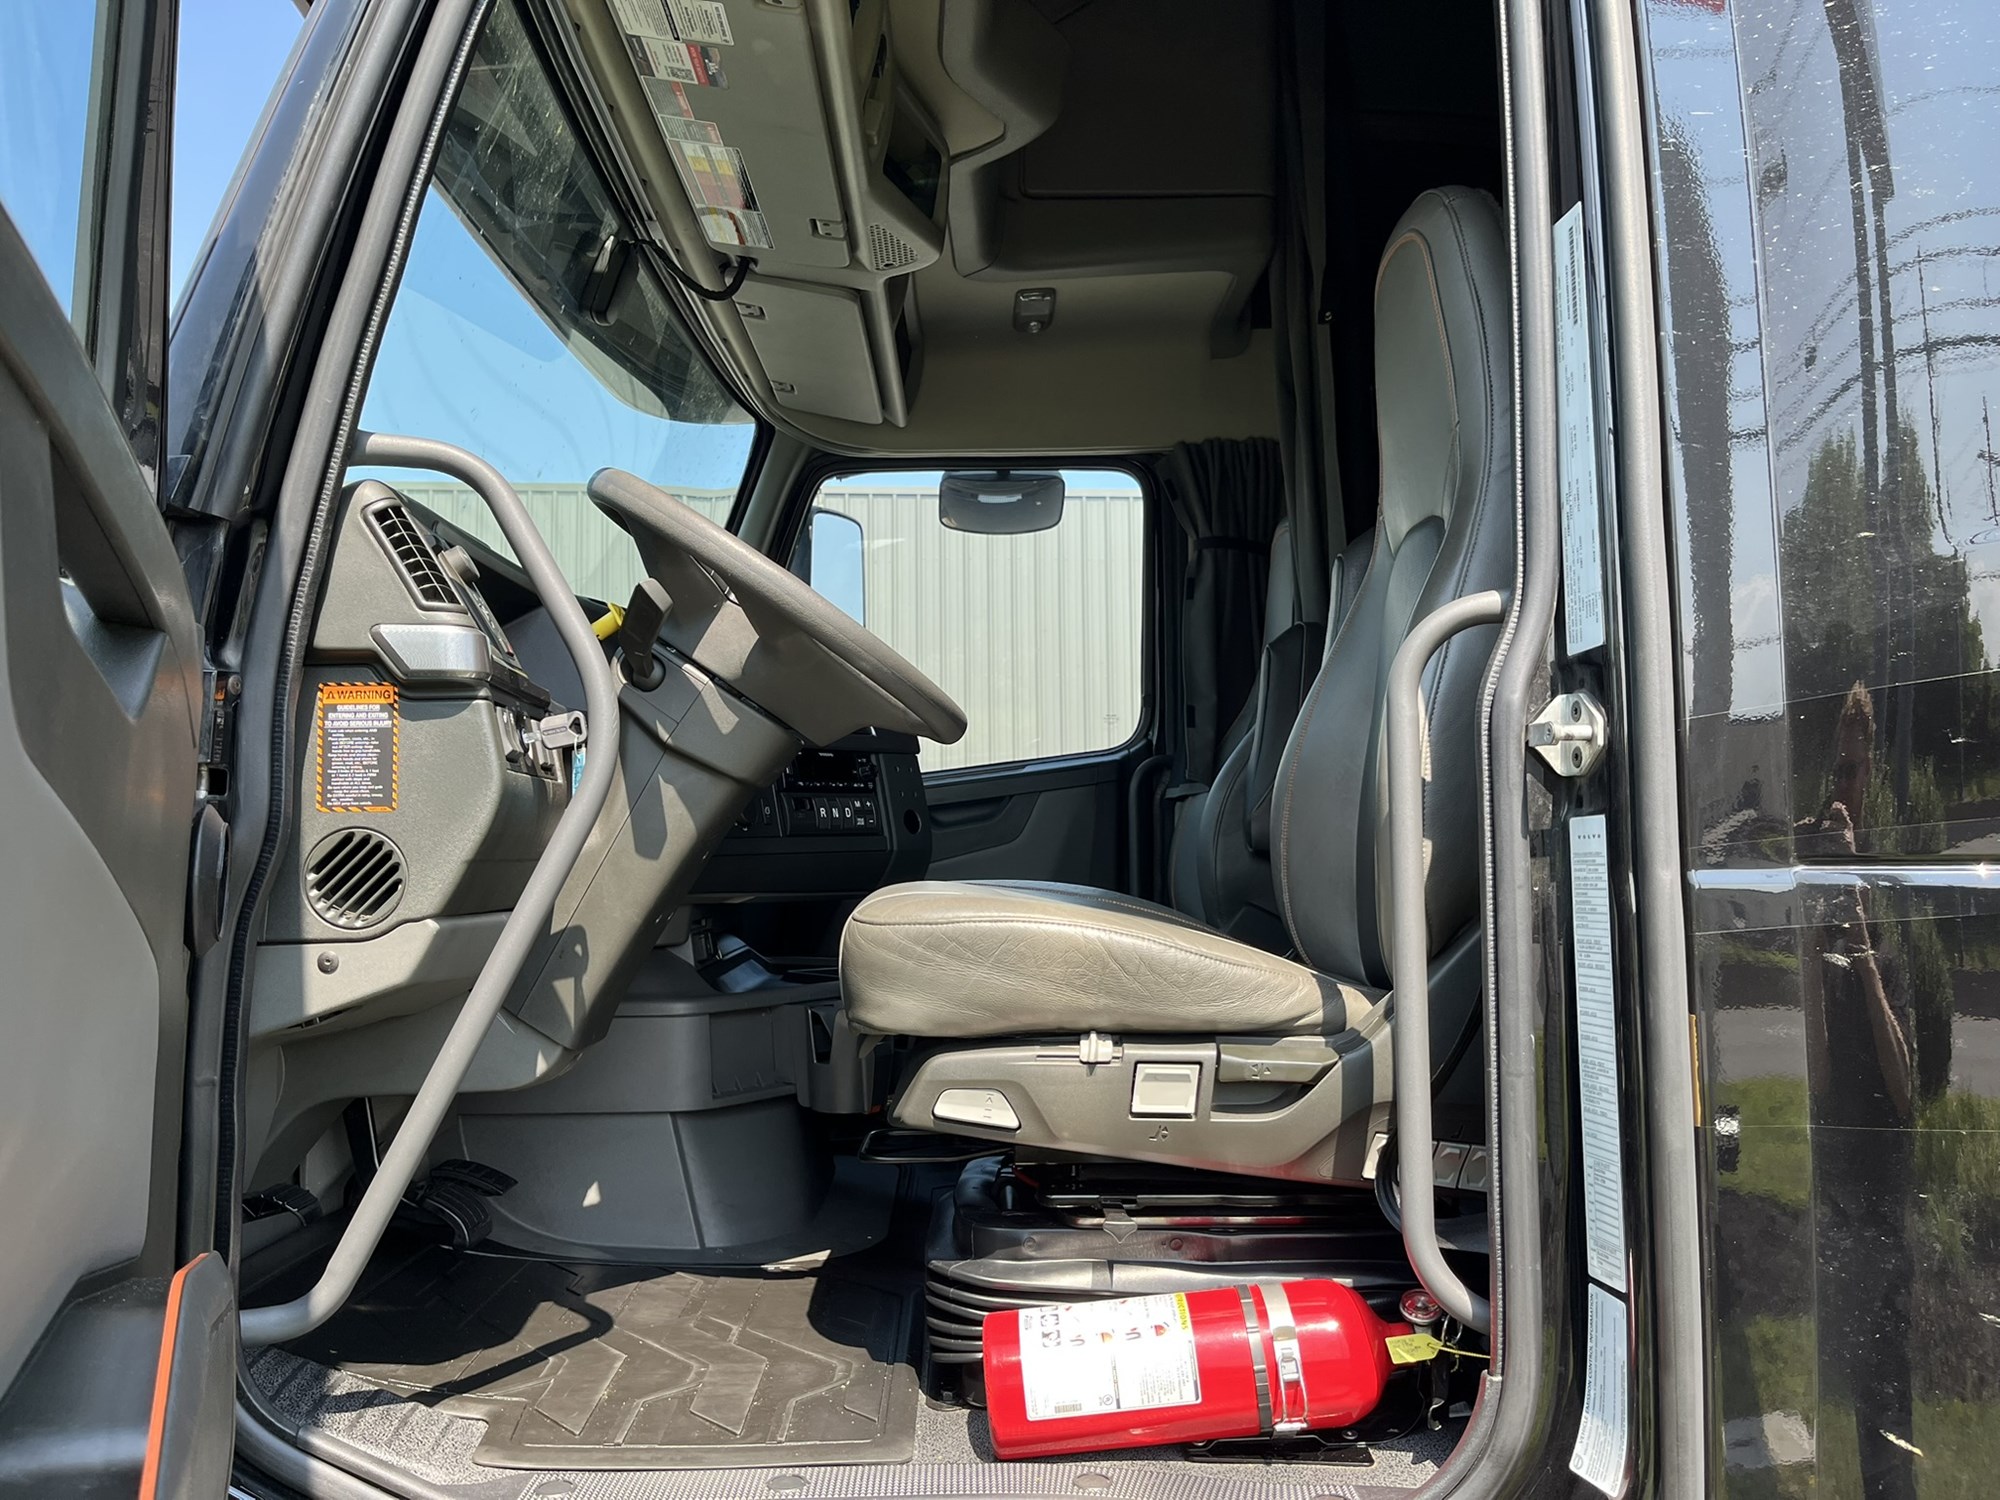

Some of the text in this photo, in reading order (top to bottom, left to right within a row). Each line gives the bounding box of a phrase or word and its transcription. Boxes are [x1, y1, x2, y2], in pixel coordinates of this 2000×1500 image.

[337, 690, 391, 699] WARNING
[820, 808, 851, 818] R N D
[1578, 1415, 1588, 1444] VEHICLE
[1584, 1380, 1592, 1414] EMISSION
